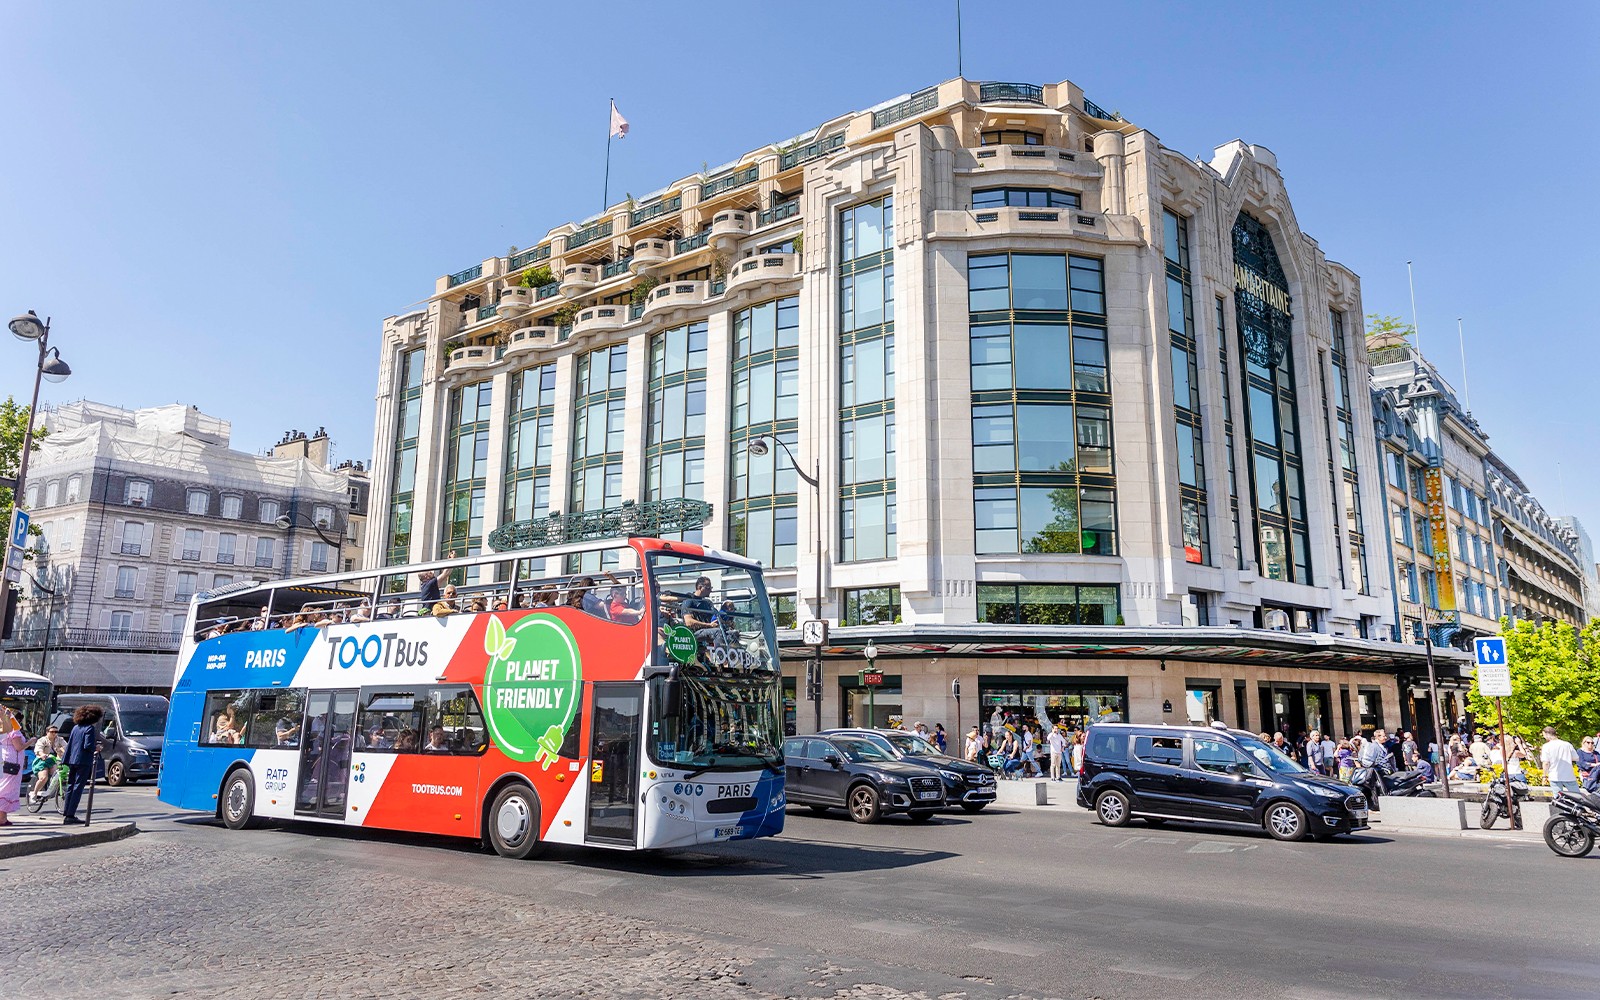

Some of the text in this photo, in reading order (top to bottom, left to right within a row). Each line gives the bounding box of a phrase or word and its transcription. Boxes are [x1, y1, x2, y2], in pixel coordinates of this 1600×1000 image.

[1234, 263, 1291, 317] AMARITAINE
[17, 517, 26, 540] P
[672, 643, 694, 651] FRIENDLY
[673, 636, 691, 644] PLANET
[207, 654, 227, 662] HOP-ON
[328, 632, 429, 670] TOOTBUS
[244, 648, 287, 669] PARIS
[206, 662, 227, 670] HOP-OFF
[505, 659, 560, 681] PLANET
[6, 685, 38, 696] Charléty
[496, 687, 564, 709] FRIENDLY
[266, 768, 288, 780] RATP
[265, 781, 287, 791] GROUP
[411, 783, 463, 797] TOOTBUS.COM
[717, 784, 751, 798] PARIS
